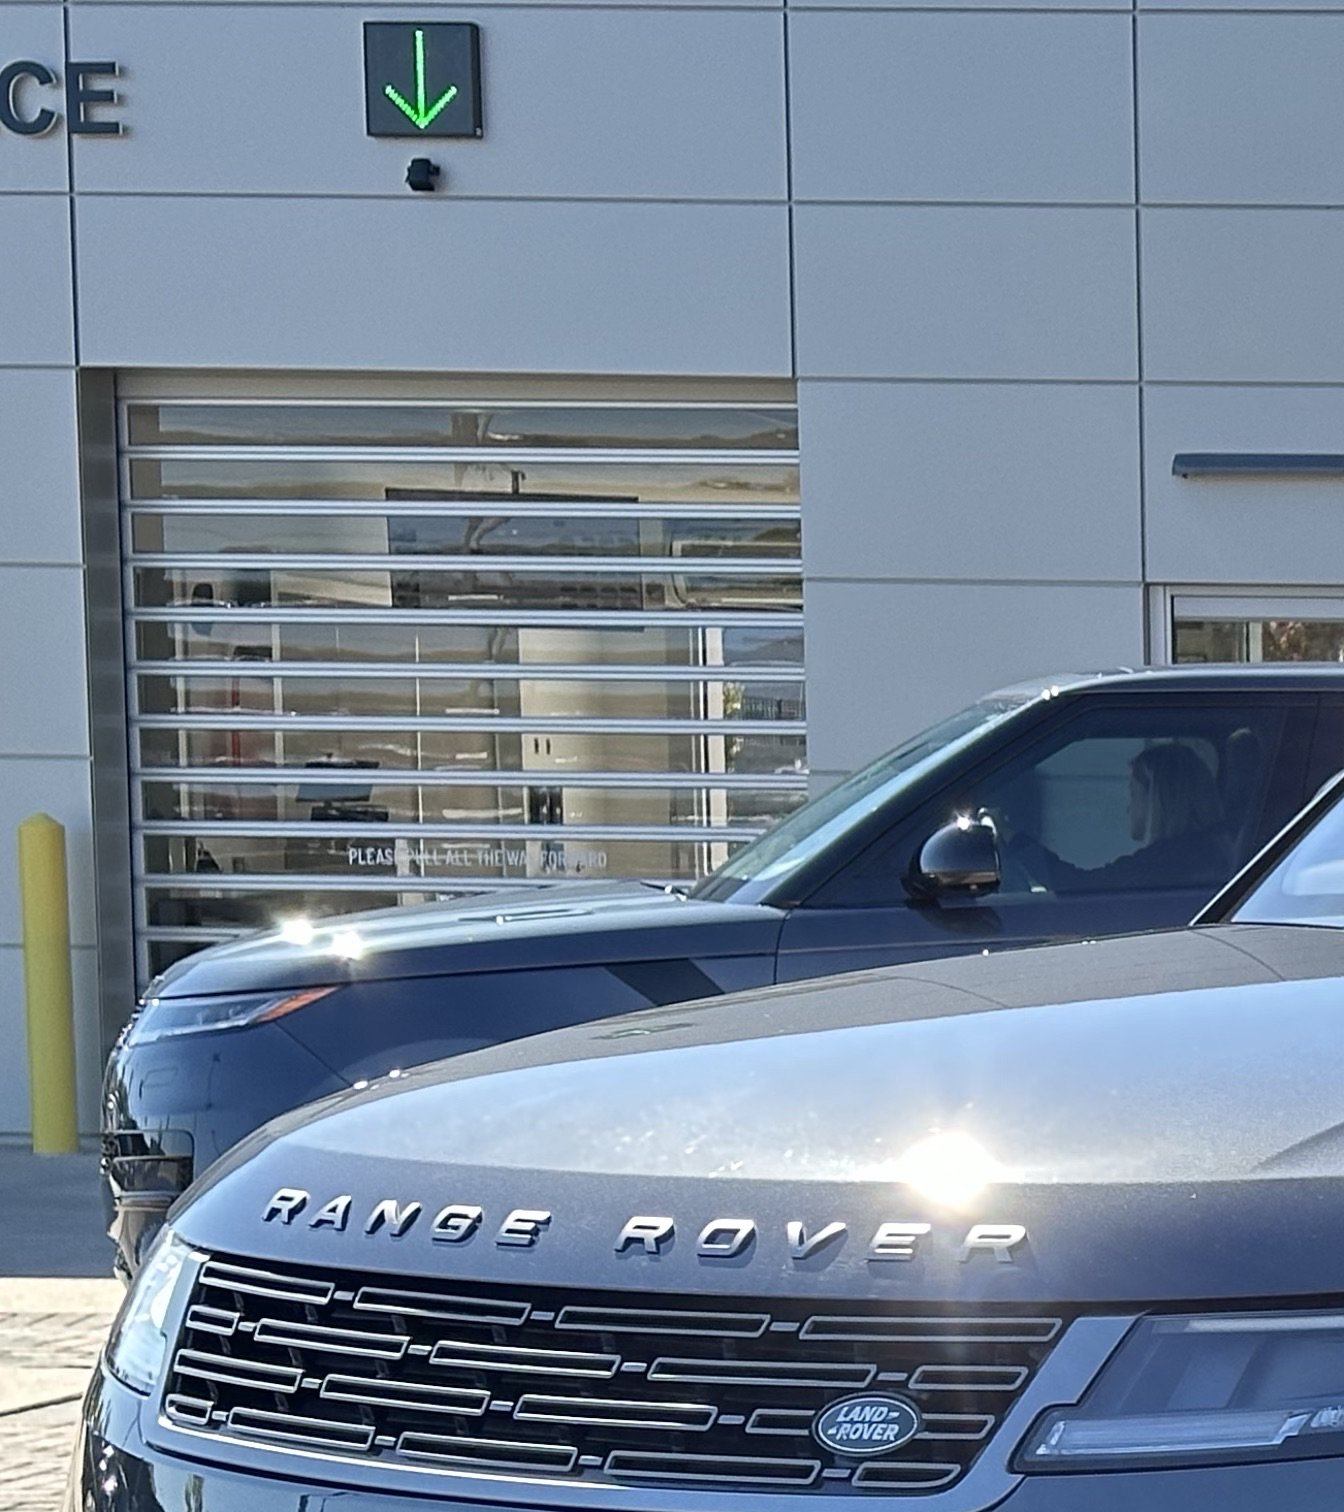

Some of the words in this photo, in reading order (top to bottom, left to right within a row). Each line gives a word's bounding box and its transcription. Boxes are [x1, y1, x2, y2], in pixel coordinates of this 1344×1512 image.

[0, 60, 123, 135] CE
[348, 847, 403, 866] PLEAS
[506, 850, 537, 867] WA
[261, 1187, 552, 1246] RANGE
[613, 1215, 1029, 1263] ROVER
